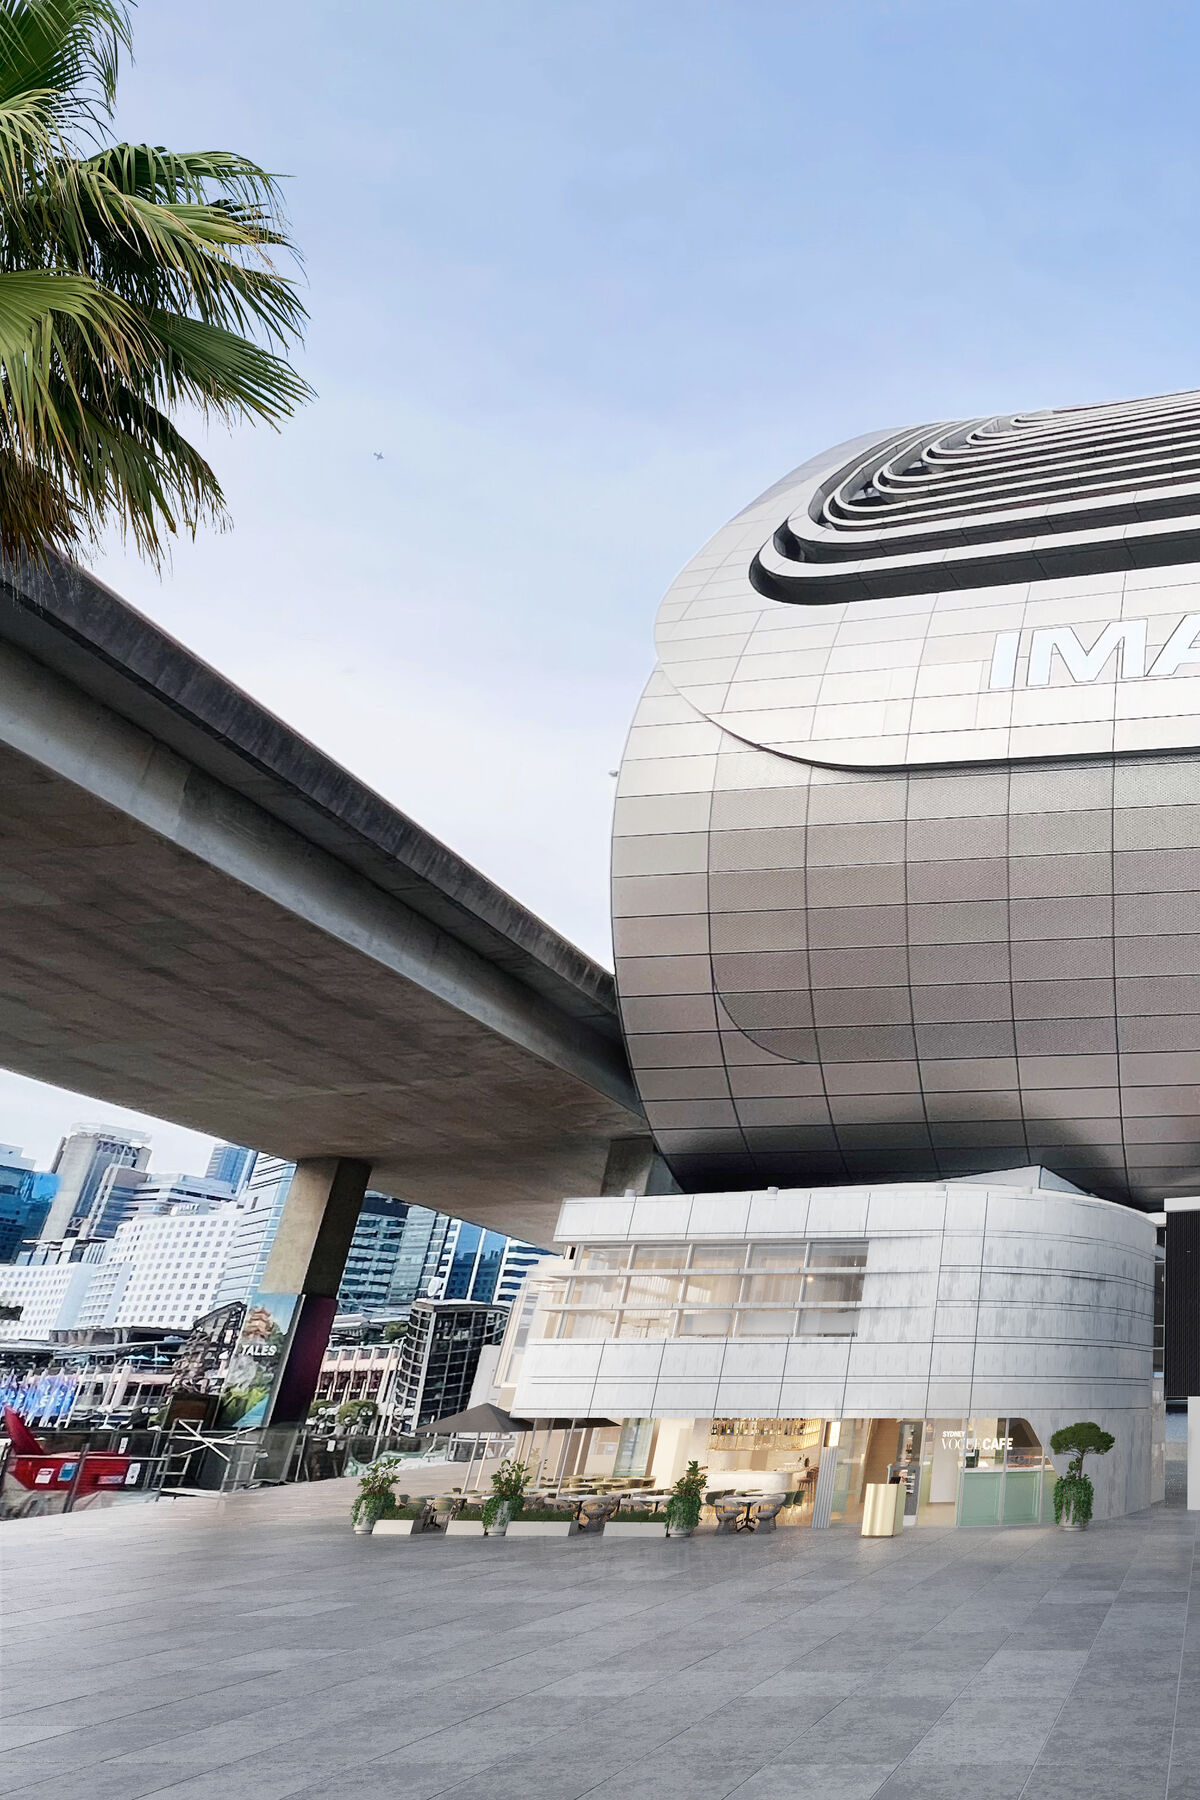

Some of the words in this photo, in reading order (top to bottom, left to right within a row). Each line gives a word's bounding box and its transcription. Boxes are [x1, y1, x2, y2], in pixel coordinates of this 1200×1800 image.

[241, 1344, 278, 1356] TALES
[942, 1430, 966, 1438] SYDNEY
[982, 1438, 1013, 1450] CAFE
